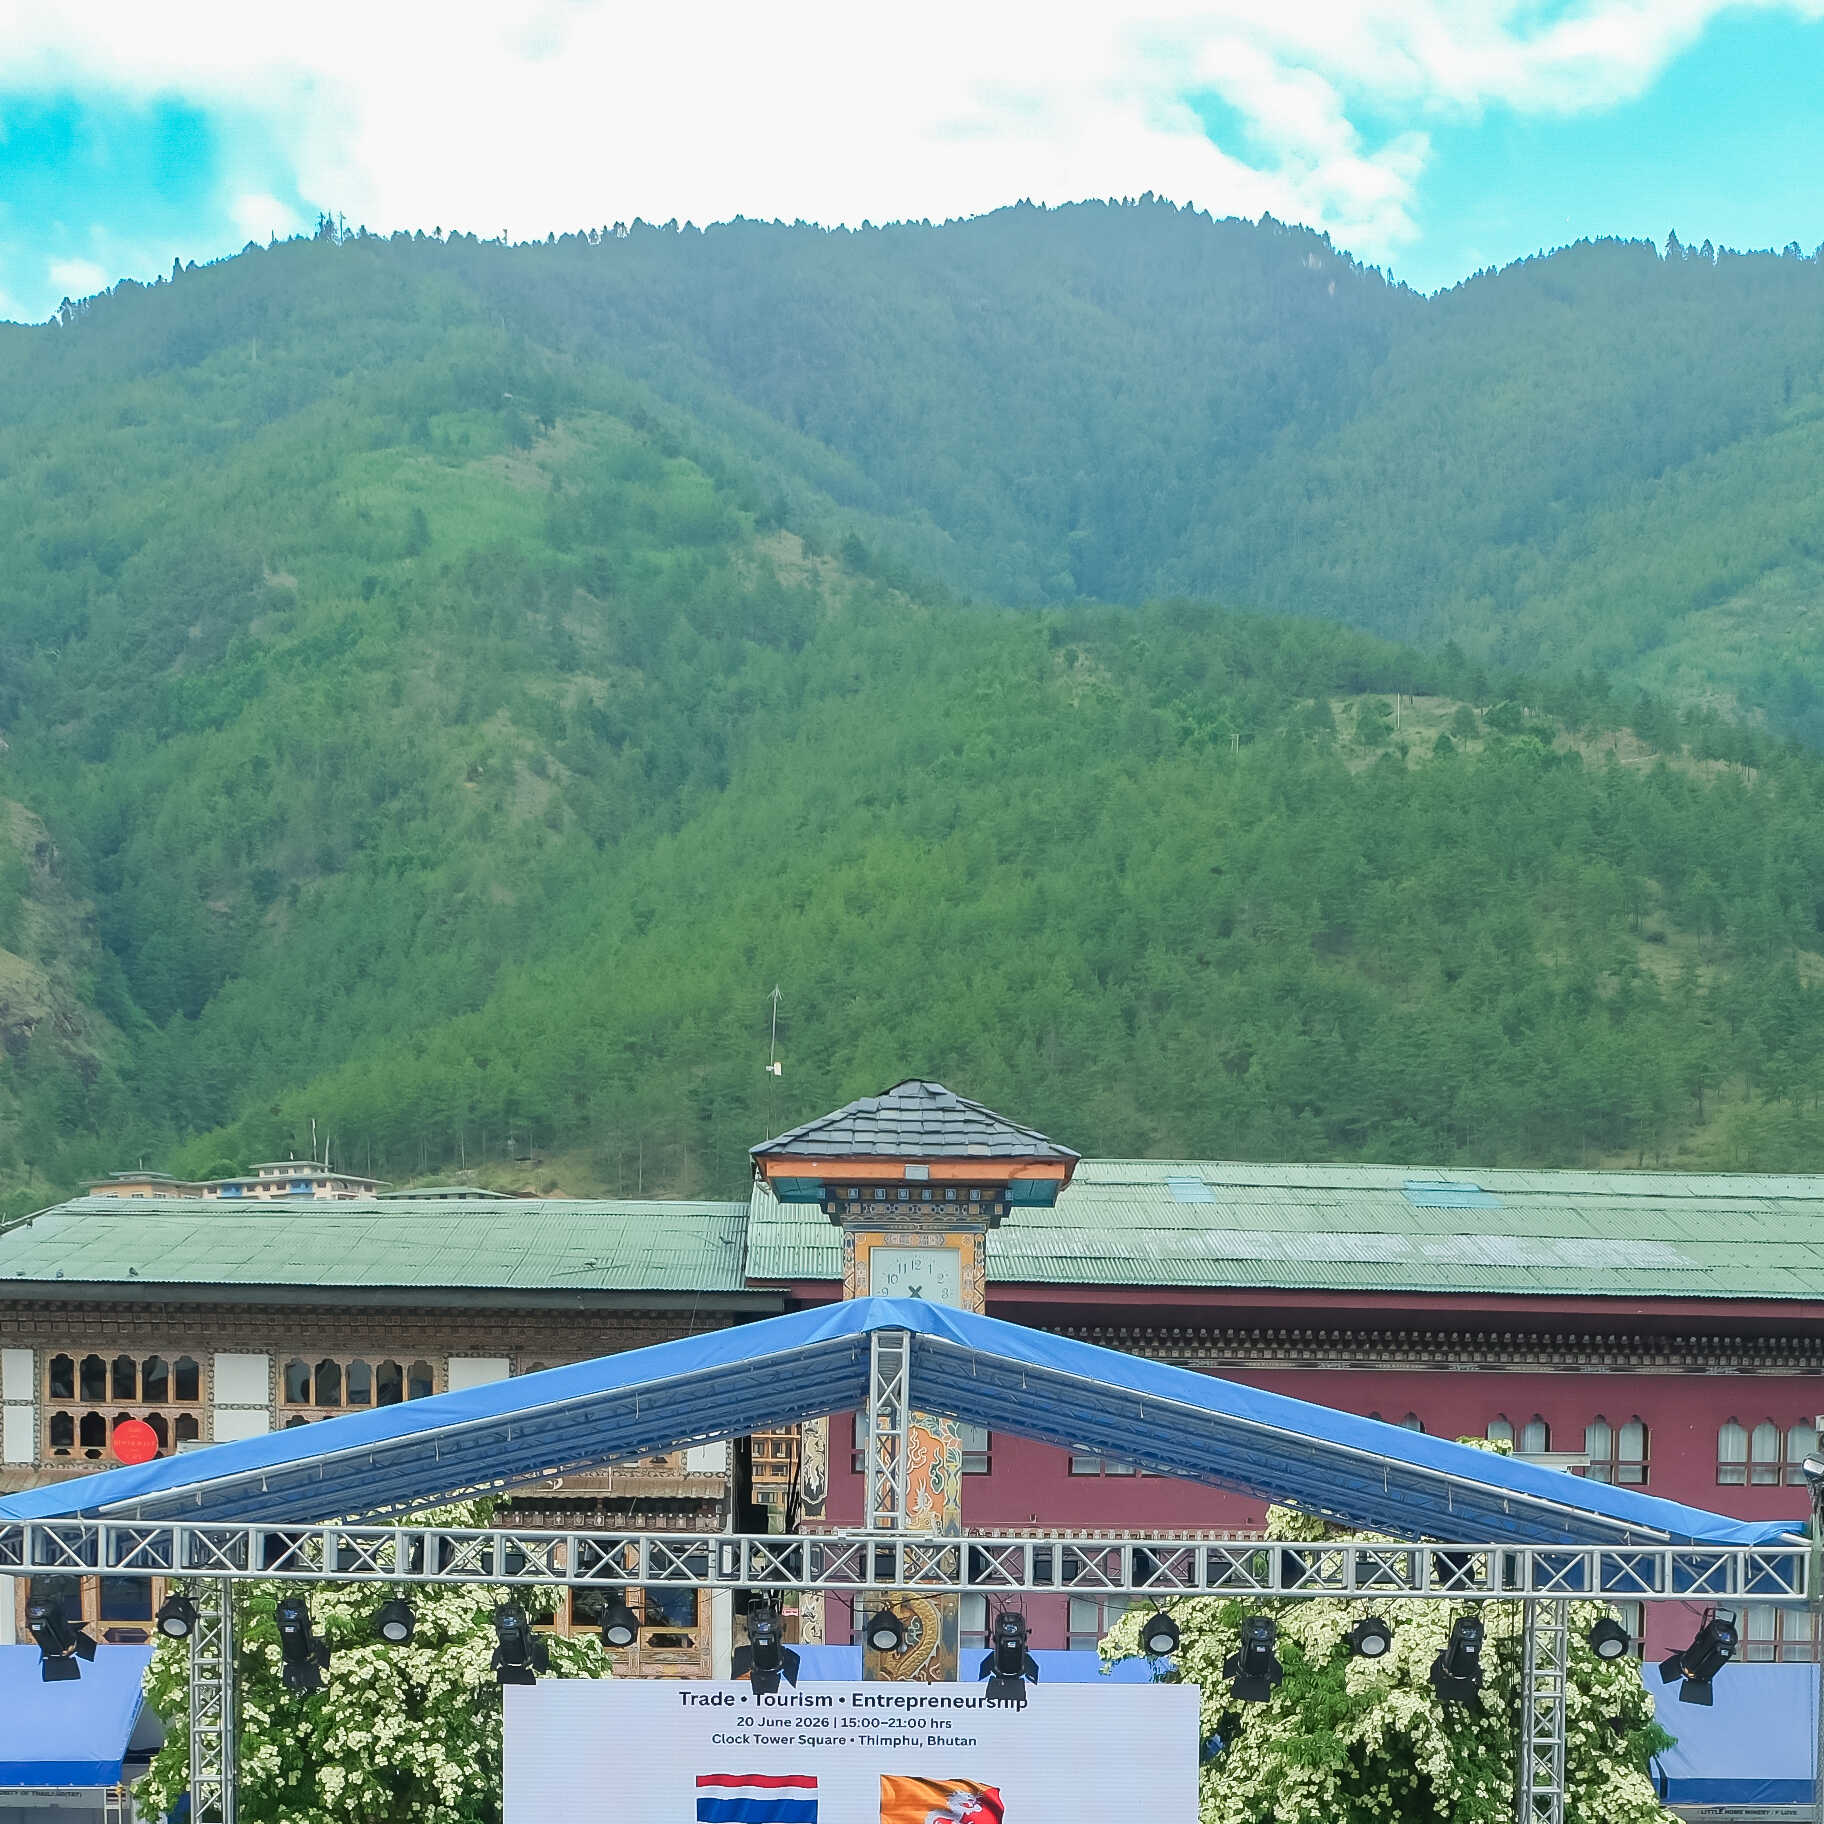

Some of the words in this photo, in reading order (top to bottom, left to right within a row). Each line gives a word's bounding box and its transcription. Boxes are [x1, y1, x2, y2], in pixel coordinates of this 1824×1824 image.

[678, 1691, 735, 1707] Trade
[753, 1692, 833, 1707] Tourism
[852, 1692, 1028, 1711] Entrepreneurship
[736, 1717, 754, 1728] 20
[758, 1717, 792, 1728] June
[795, 1717, 829, 1728] 2026
[930, 1717, 952, 1729] hrs
[711, 1733, 750, 1745] Clock
[753, 1734, 795, 1745] Tower
[798, 1734, 846, 1748] Square
[858, 1734, 923, 1748] Thimphu,
[927, 1735, 977, 1747] Bhutan
